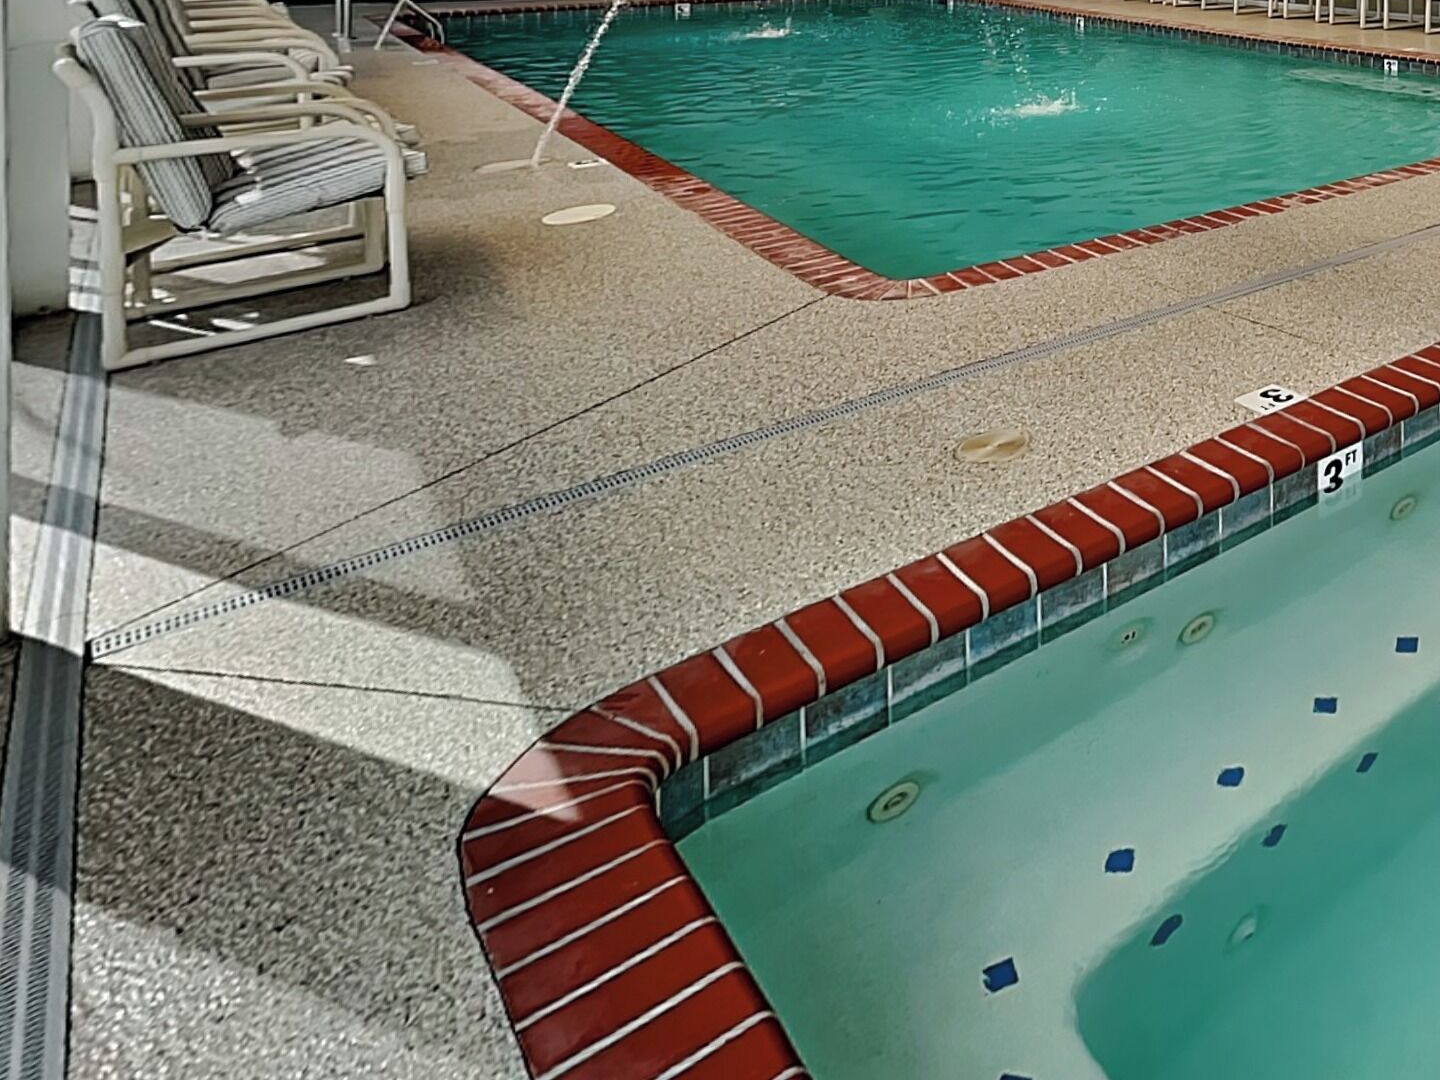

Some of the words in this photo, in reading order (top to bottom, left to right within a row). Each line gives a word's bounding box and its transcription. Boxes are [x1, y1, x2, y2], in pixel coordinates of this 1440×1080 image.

[1259, 389, 1294, 403] 3
[1323, 458, 1344, 494] 3
[1345, 449, 1358, 466] FT
